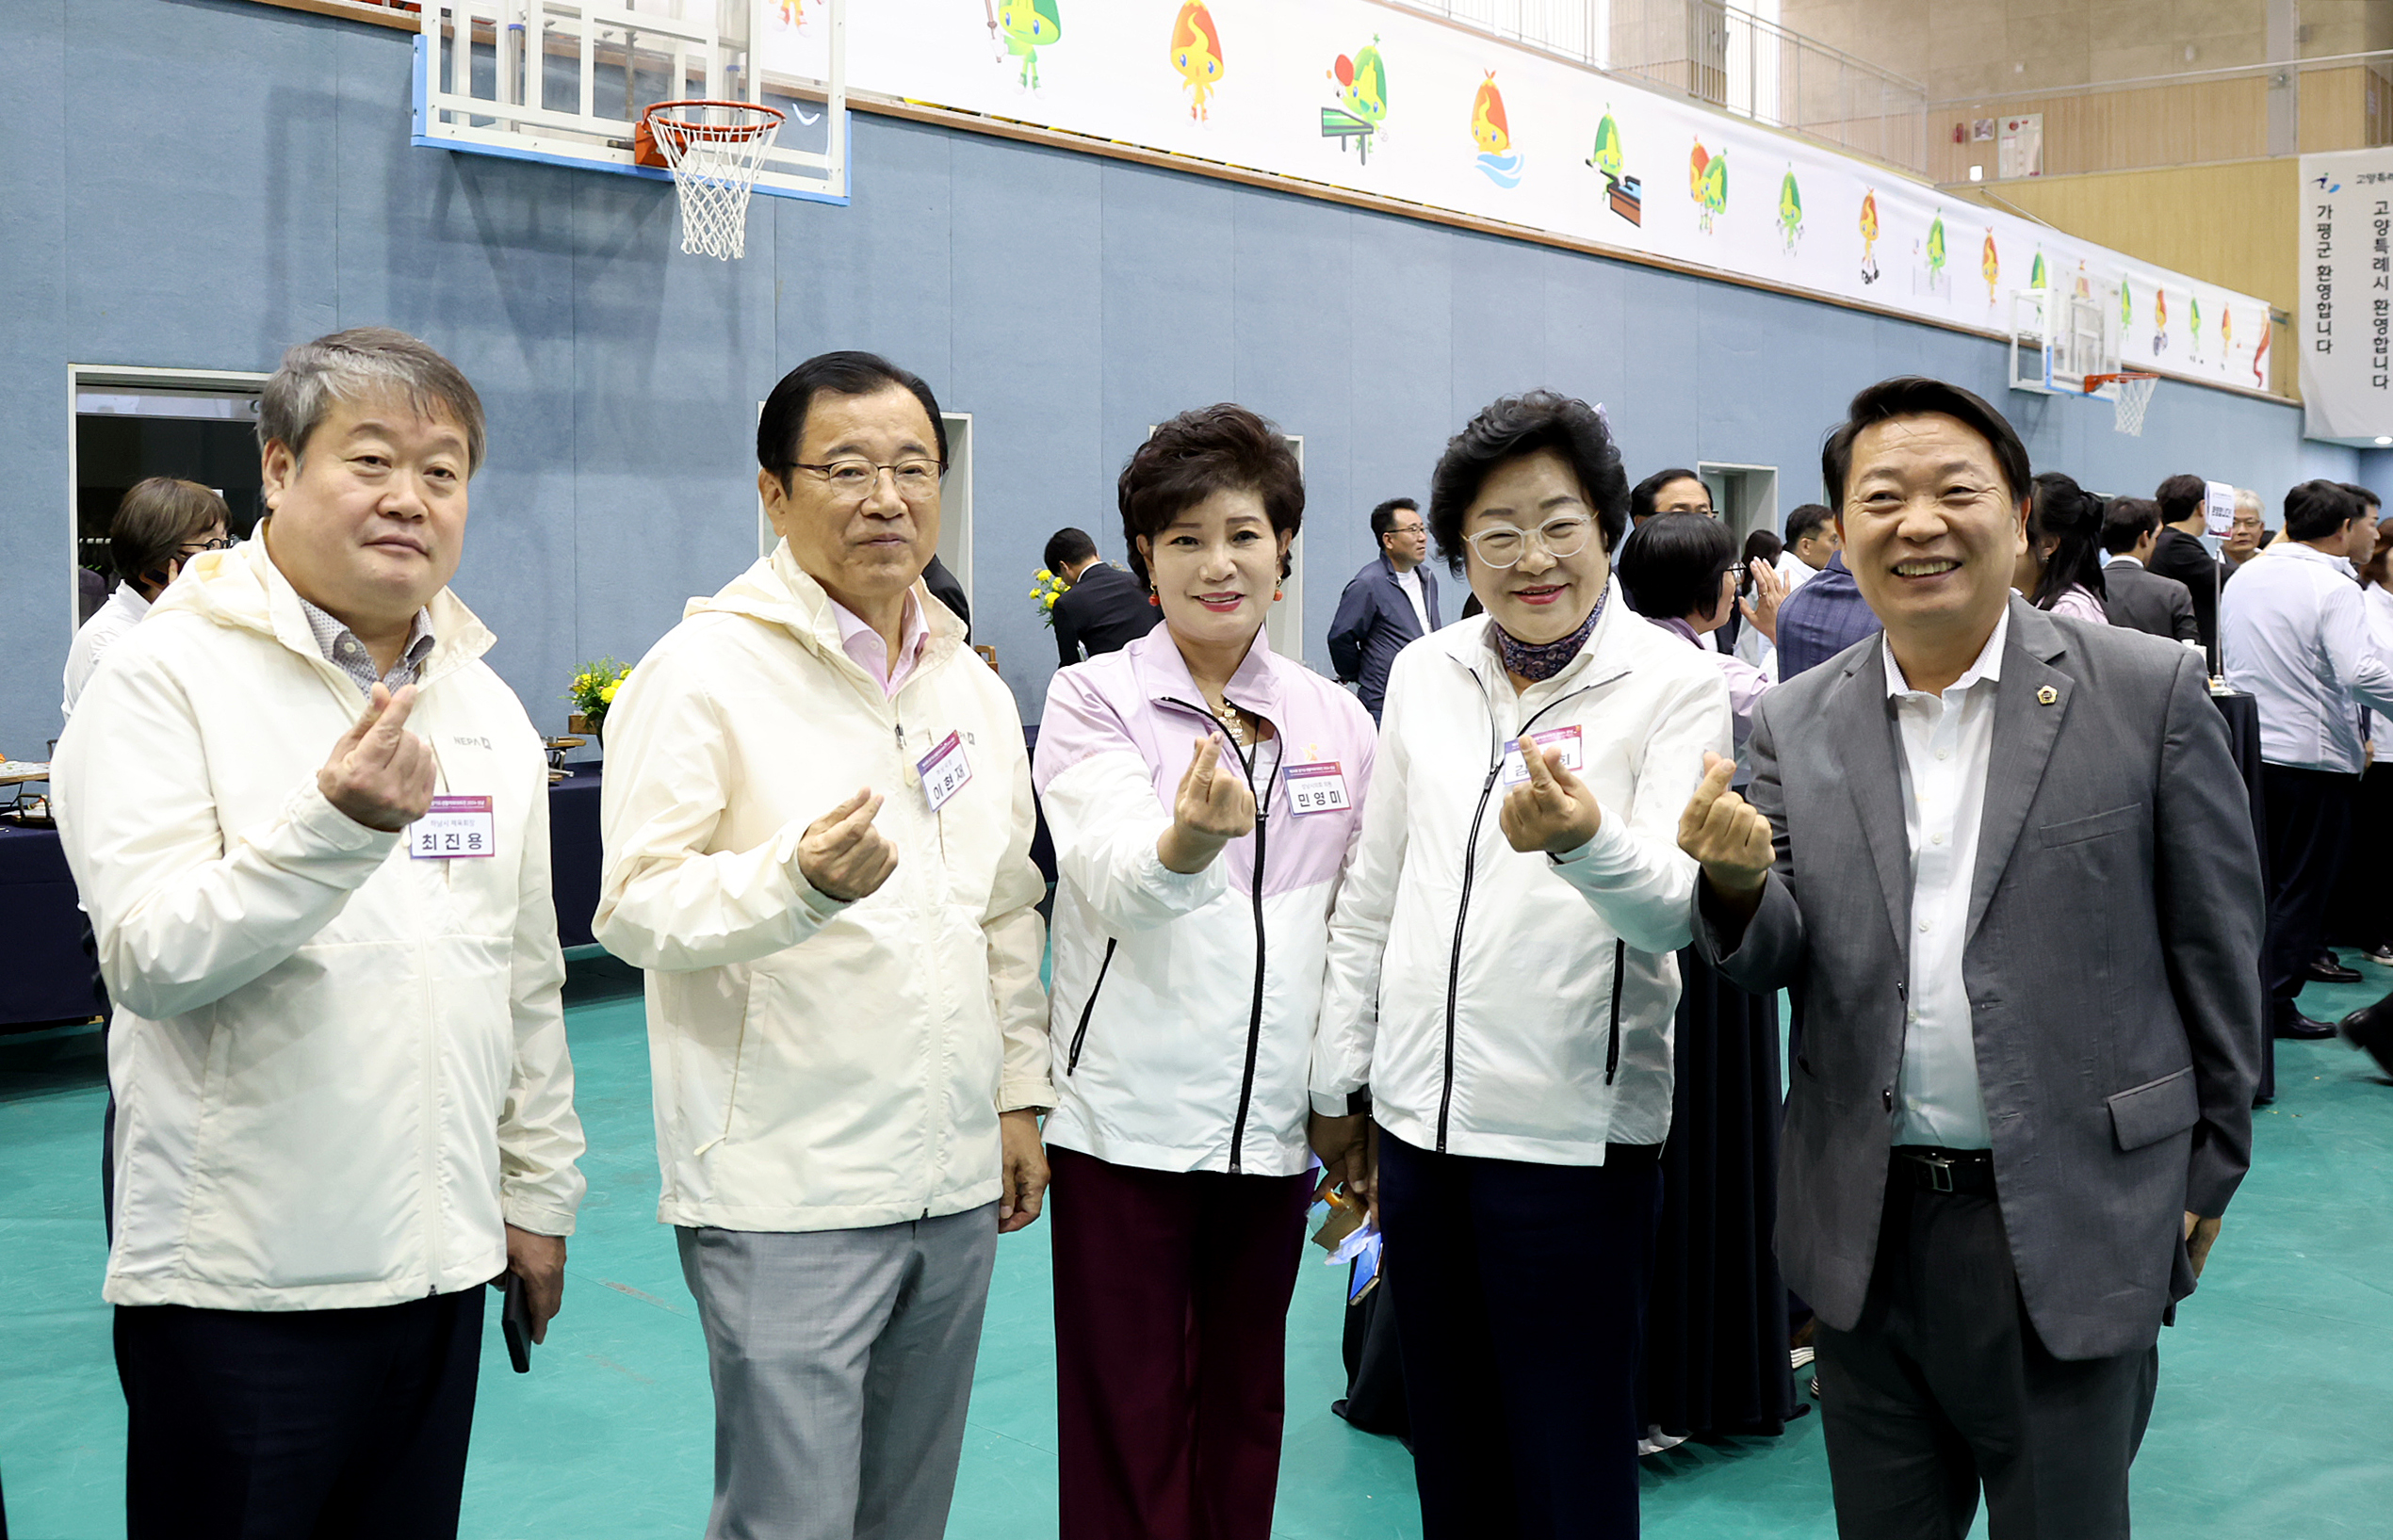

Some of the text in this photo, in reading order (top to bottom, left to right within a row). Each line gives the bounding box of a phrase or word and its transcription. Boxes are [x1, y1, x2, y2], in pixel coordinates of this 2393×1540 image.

[2317, 203, 2333, 354] 가평군 환영합니다
[2373, 200, 2390, 390] 고양특례시 환영합니다
[453, 736, 480, 746] NEPA
